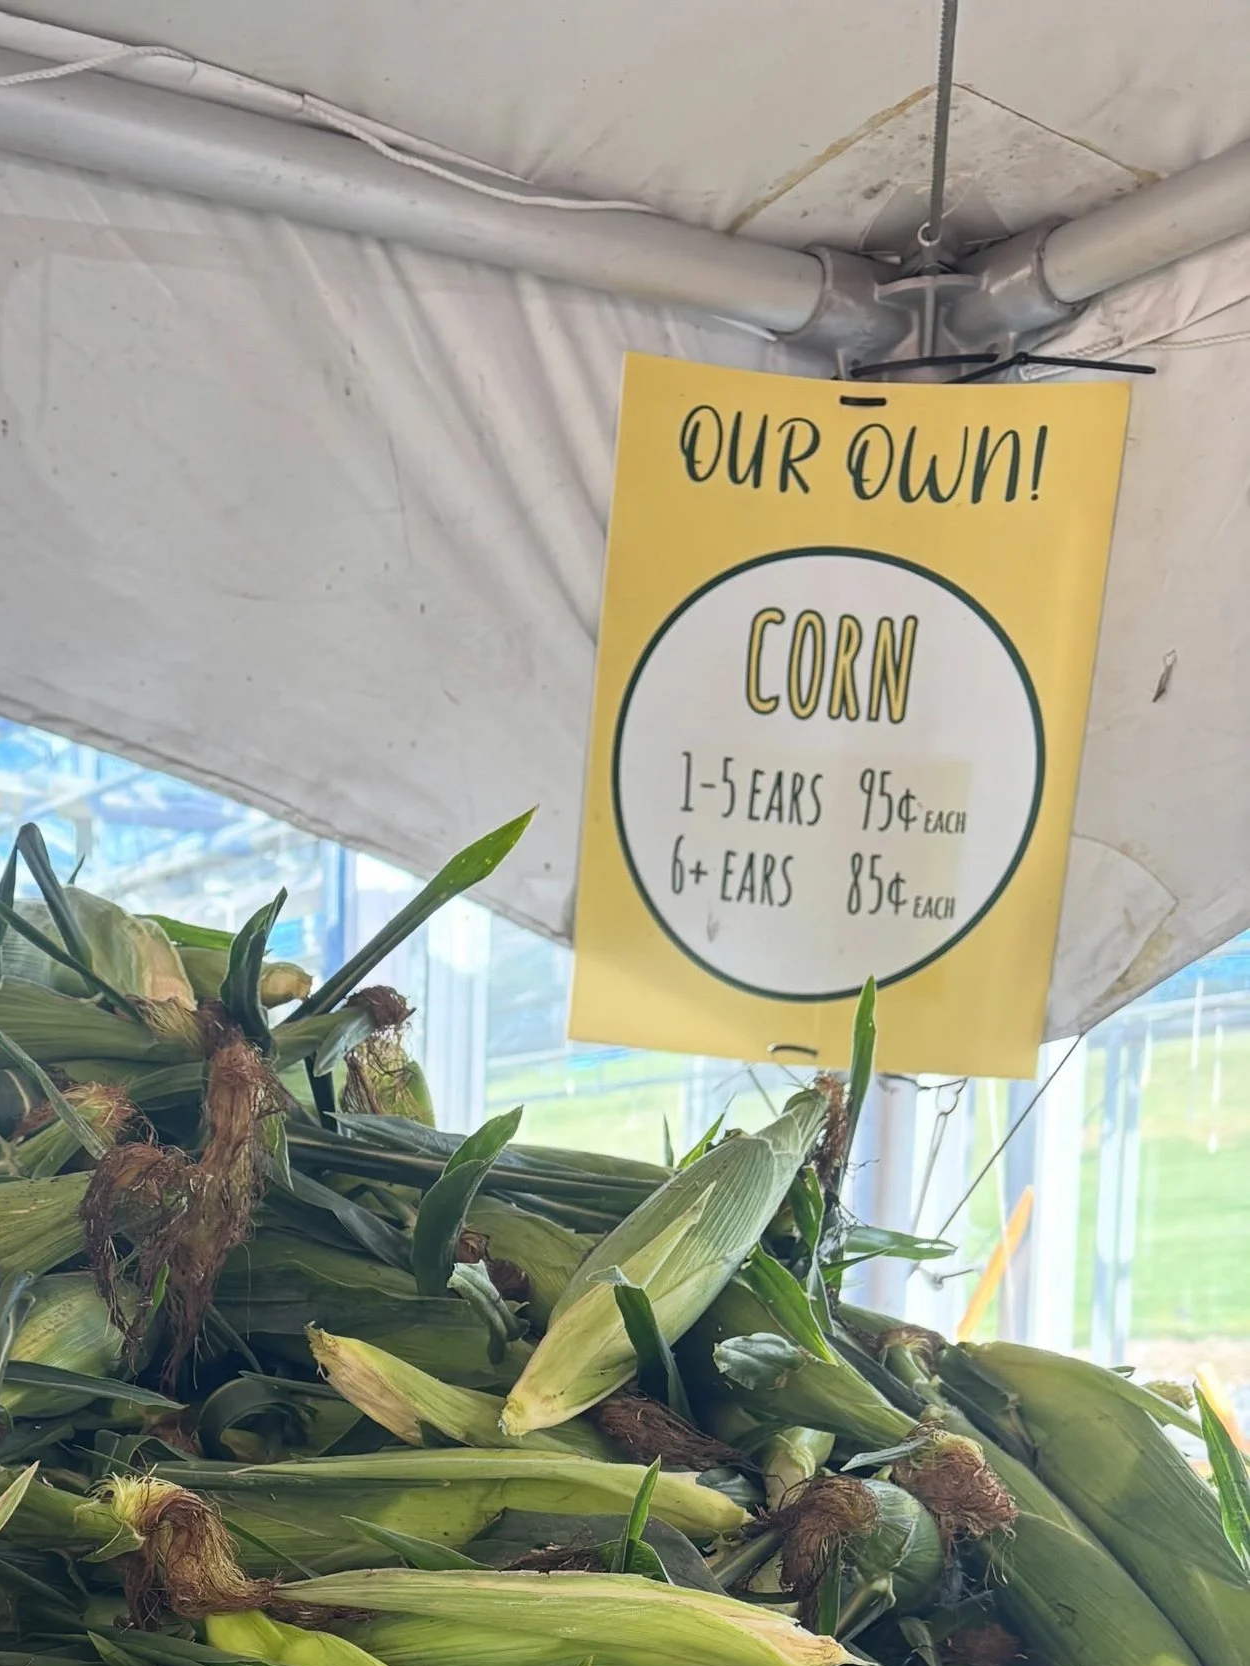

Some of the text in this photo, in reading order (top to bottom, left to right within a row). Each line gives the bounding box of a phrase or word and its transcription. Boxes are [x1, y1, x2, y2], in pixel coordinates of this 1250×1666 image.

[679, 404, 1049, 505] OUR OWN!
[745, 606, 919, 724] CORN
[679, 751, 968, 835] 1-5 EARS 95¢ EACH
[670, 834, 956, 921] 6+ EARS 85¢ EACH
